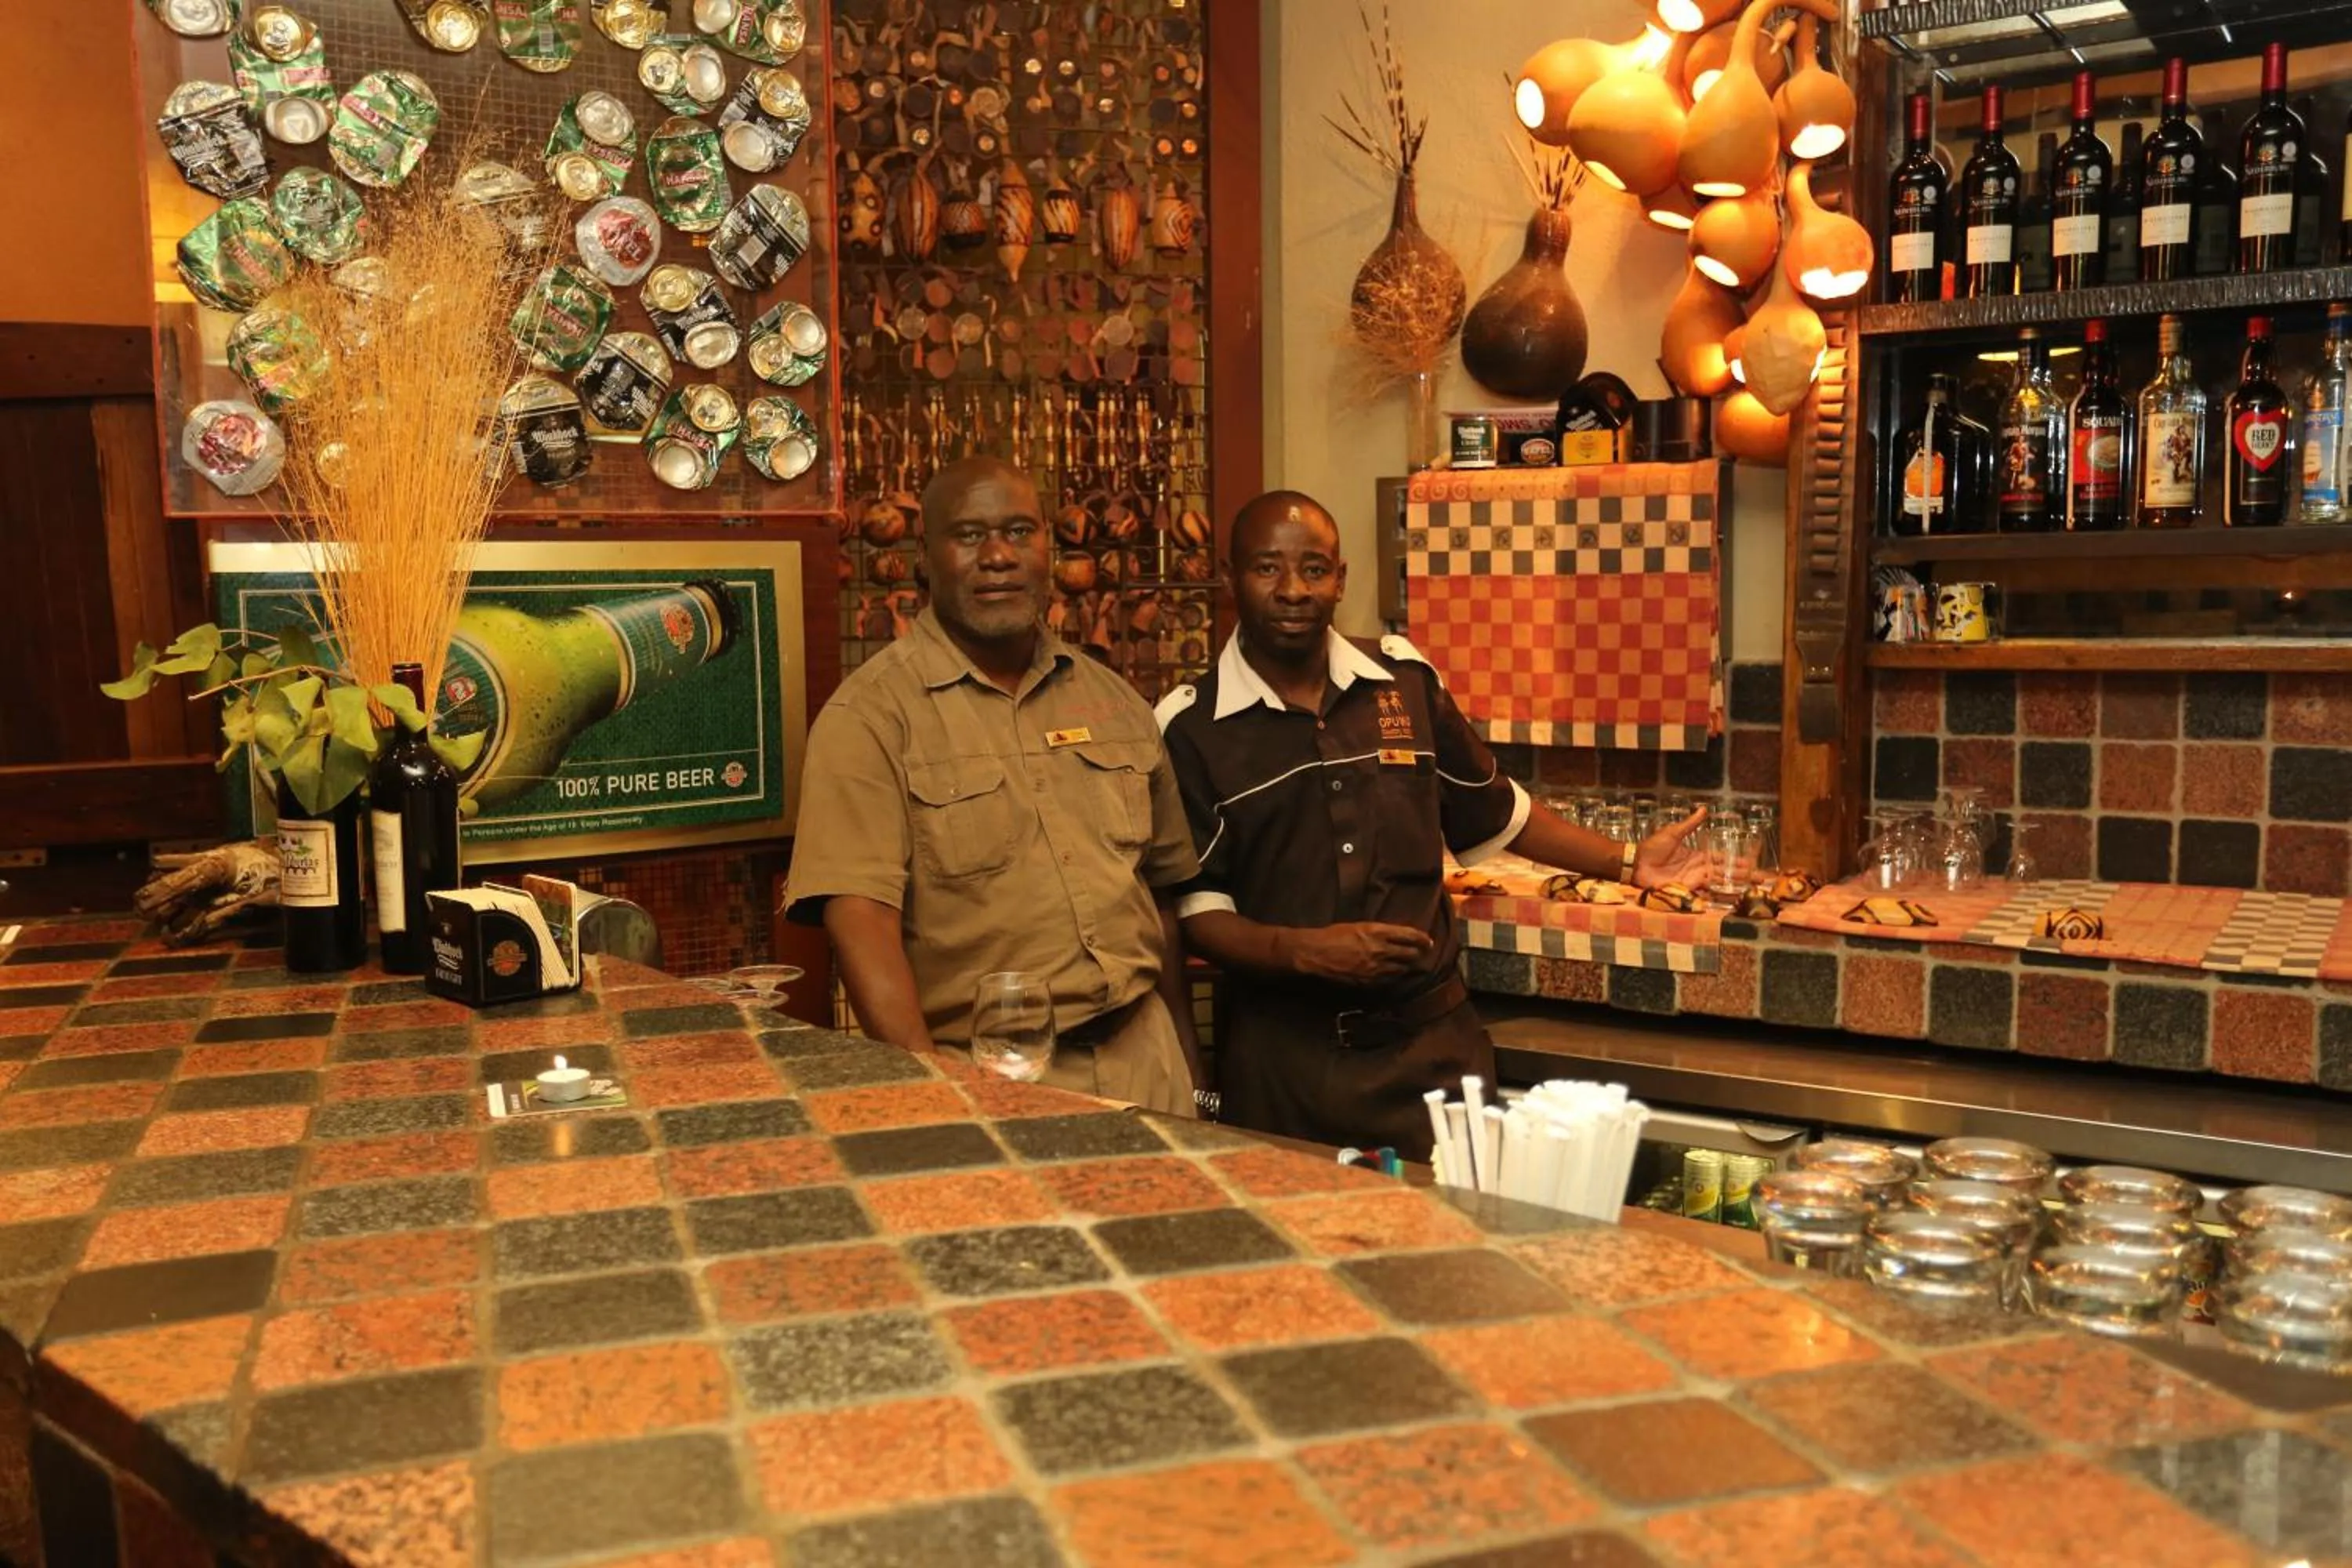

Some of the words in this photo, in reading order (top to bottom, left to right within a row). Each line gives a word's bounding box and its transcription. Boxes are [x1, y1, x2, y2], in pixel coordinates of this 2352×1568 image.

[557, 775, 600, 798] 100%
[608, 772, 659, 794] PURE
[666, 768, 714, 789] BEER
